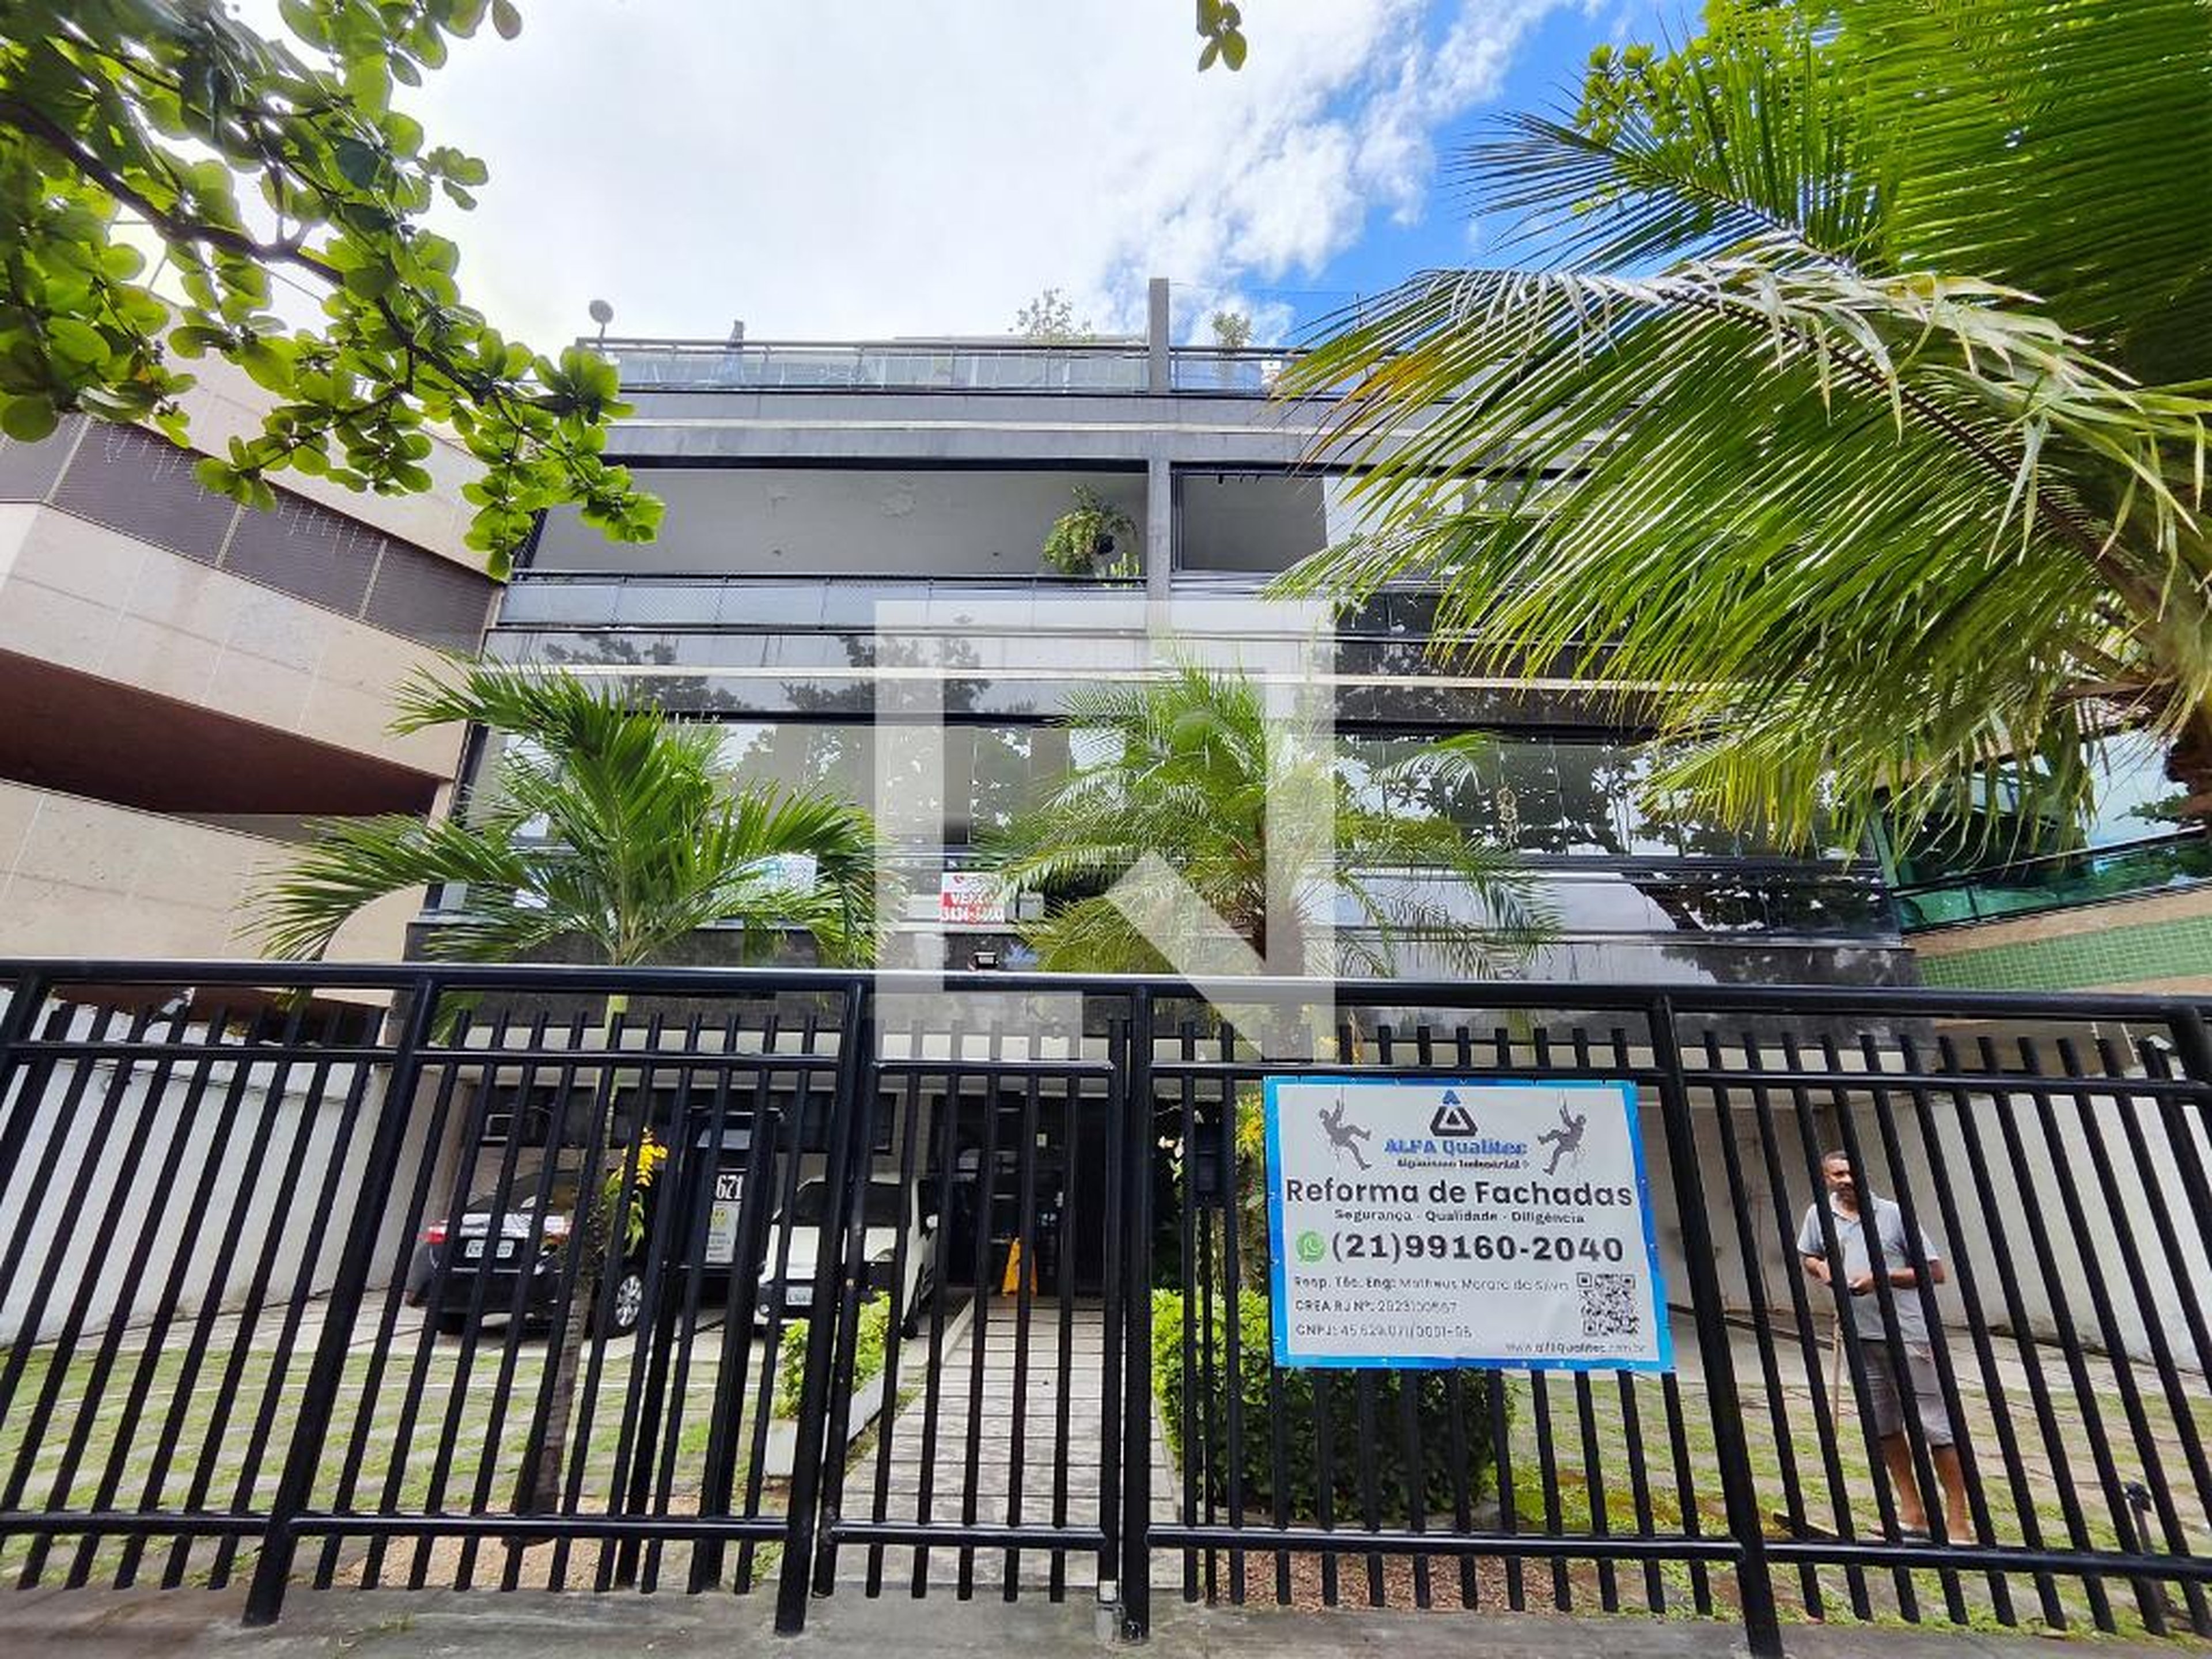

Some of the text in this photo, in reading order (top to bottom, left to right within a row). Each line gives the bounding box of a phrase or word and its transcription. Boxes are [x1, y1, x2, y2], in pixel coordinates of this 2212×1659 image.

[1384, 1139, 1437, 1153] ALFA
[715, 1175, 744, 1200] 671
[1286, 1176, 1633, 1206] Reforma de Fachadas
[1334, 1209, 1585, 1225] Segurança Qualidade Diligência
[1332, 1232, 1624, 1264] (21)99160-2040
